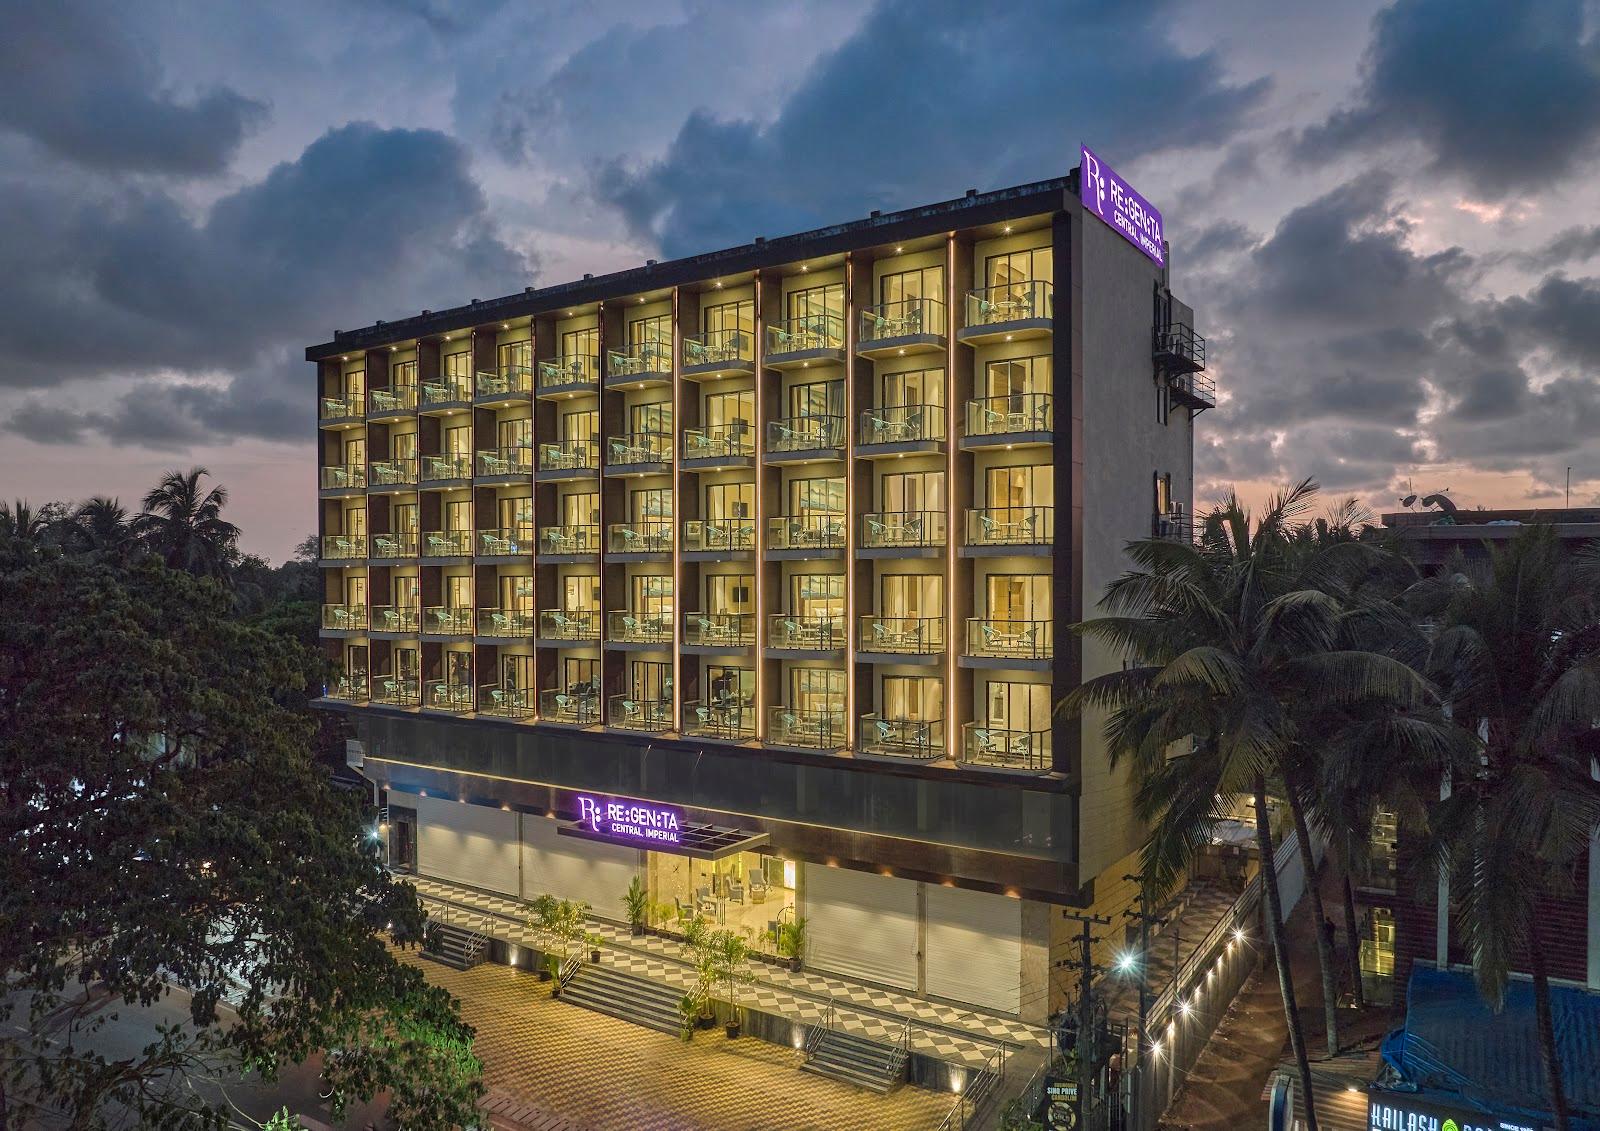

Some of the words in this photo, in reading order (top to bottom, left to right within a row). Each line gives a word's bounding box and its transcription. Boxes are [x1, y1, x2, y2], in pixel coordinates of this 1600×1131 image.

[1110, 179, 1162, 246] RE:GEN:TA
[1114, 210, 1140, 243] CENTRAL
[1140, 233, 1163, 263] IMPERIAL
[607, 803, 679, 831] RE:GEN:TA
[612, 823, 643, 837] CENTRAL
[645, 828, 679, 843] IMPERIAL
[1371, 1102, 1438, 1131] KAILASH
